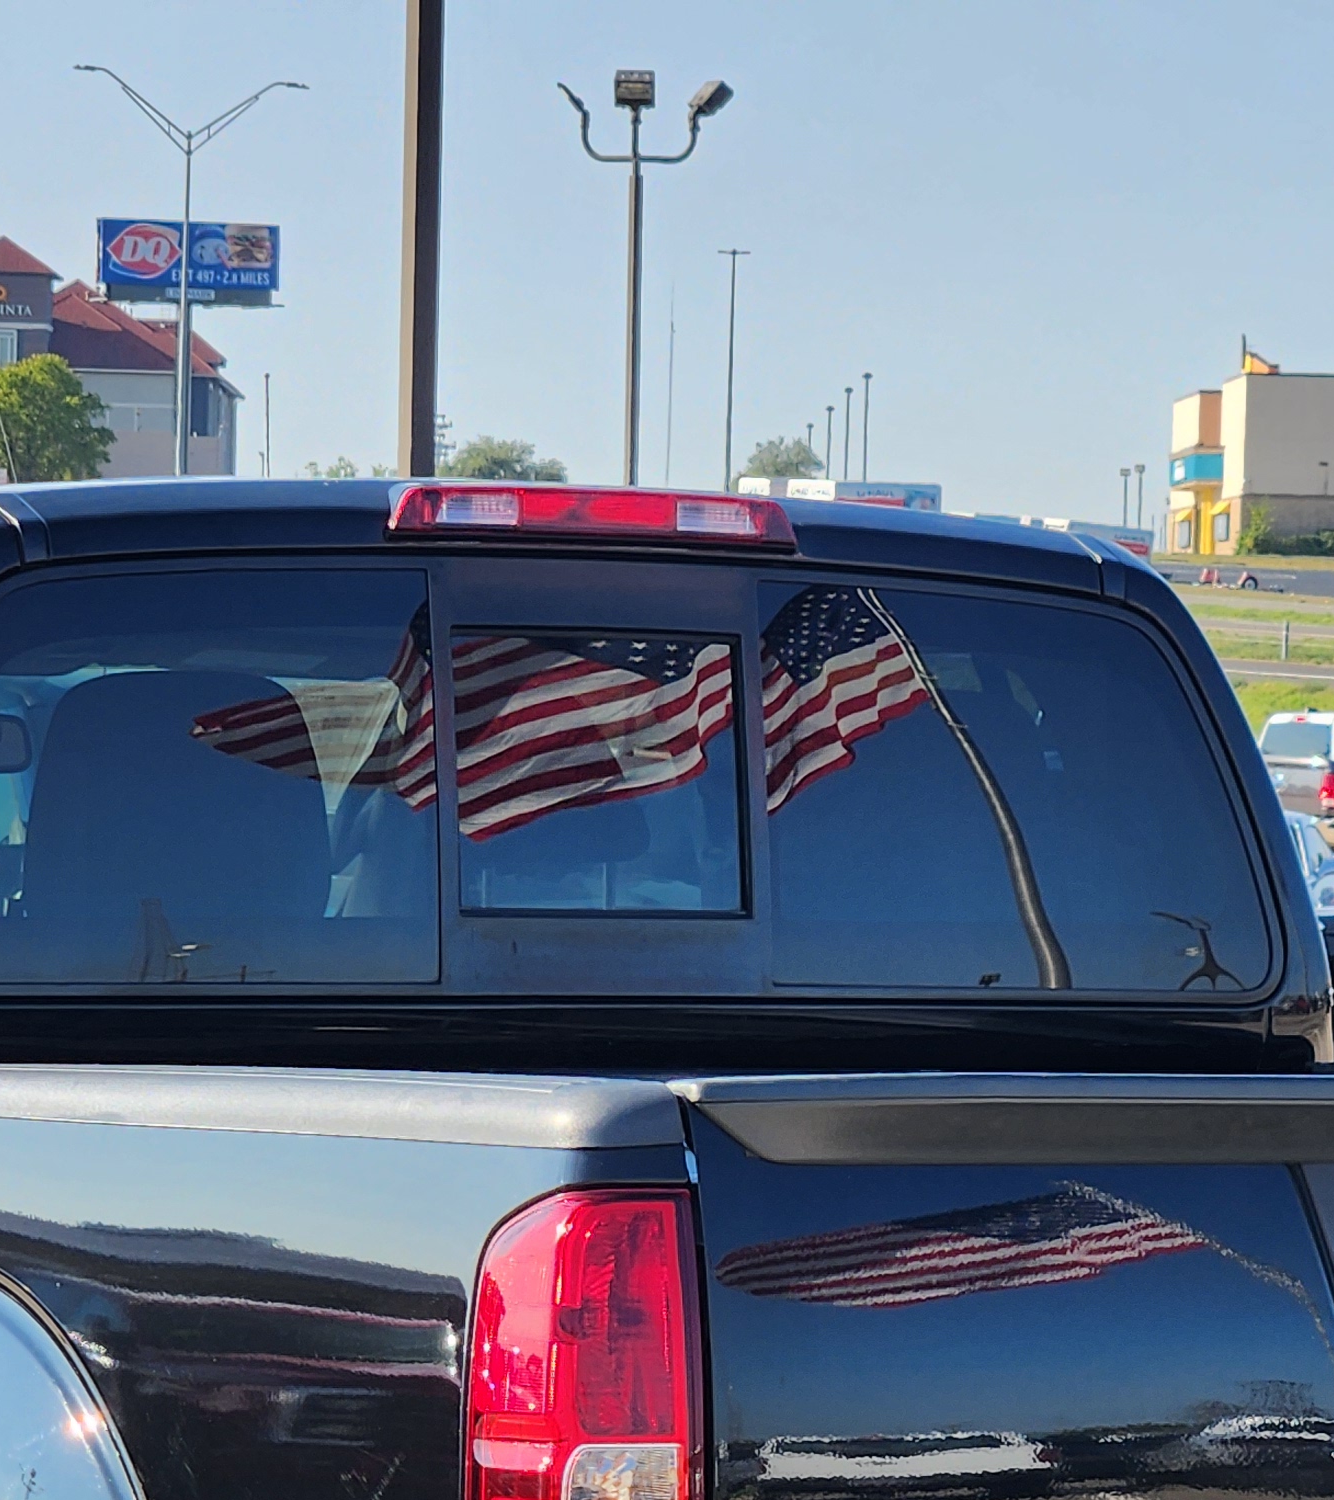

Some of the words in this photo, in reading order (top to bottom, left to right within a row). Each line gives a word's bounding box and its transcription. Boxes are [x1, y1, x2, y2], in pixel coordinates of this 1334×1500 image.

[120, 236, 169, 268] DQ
[196, 270, 215, 284] 497
[240, 271, 270, 286] MILES
